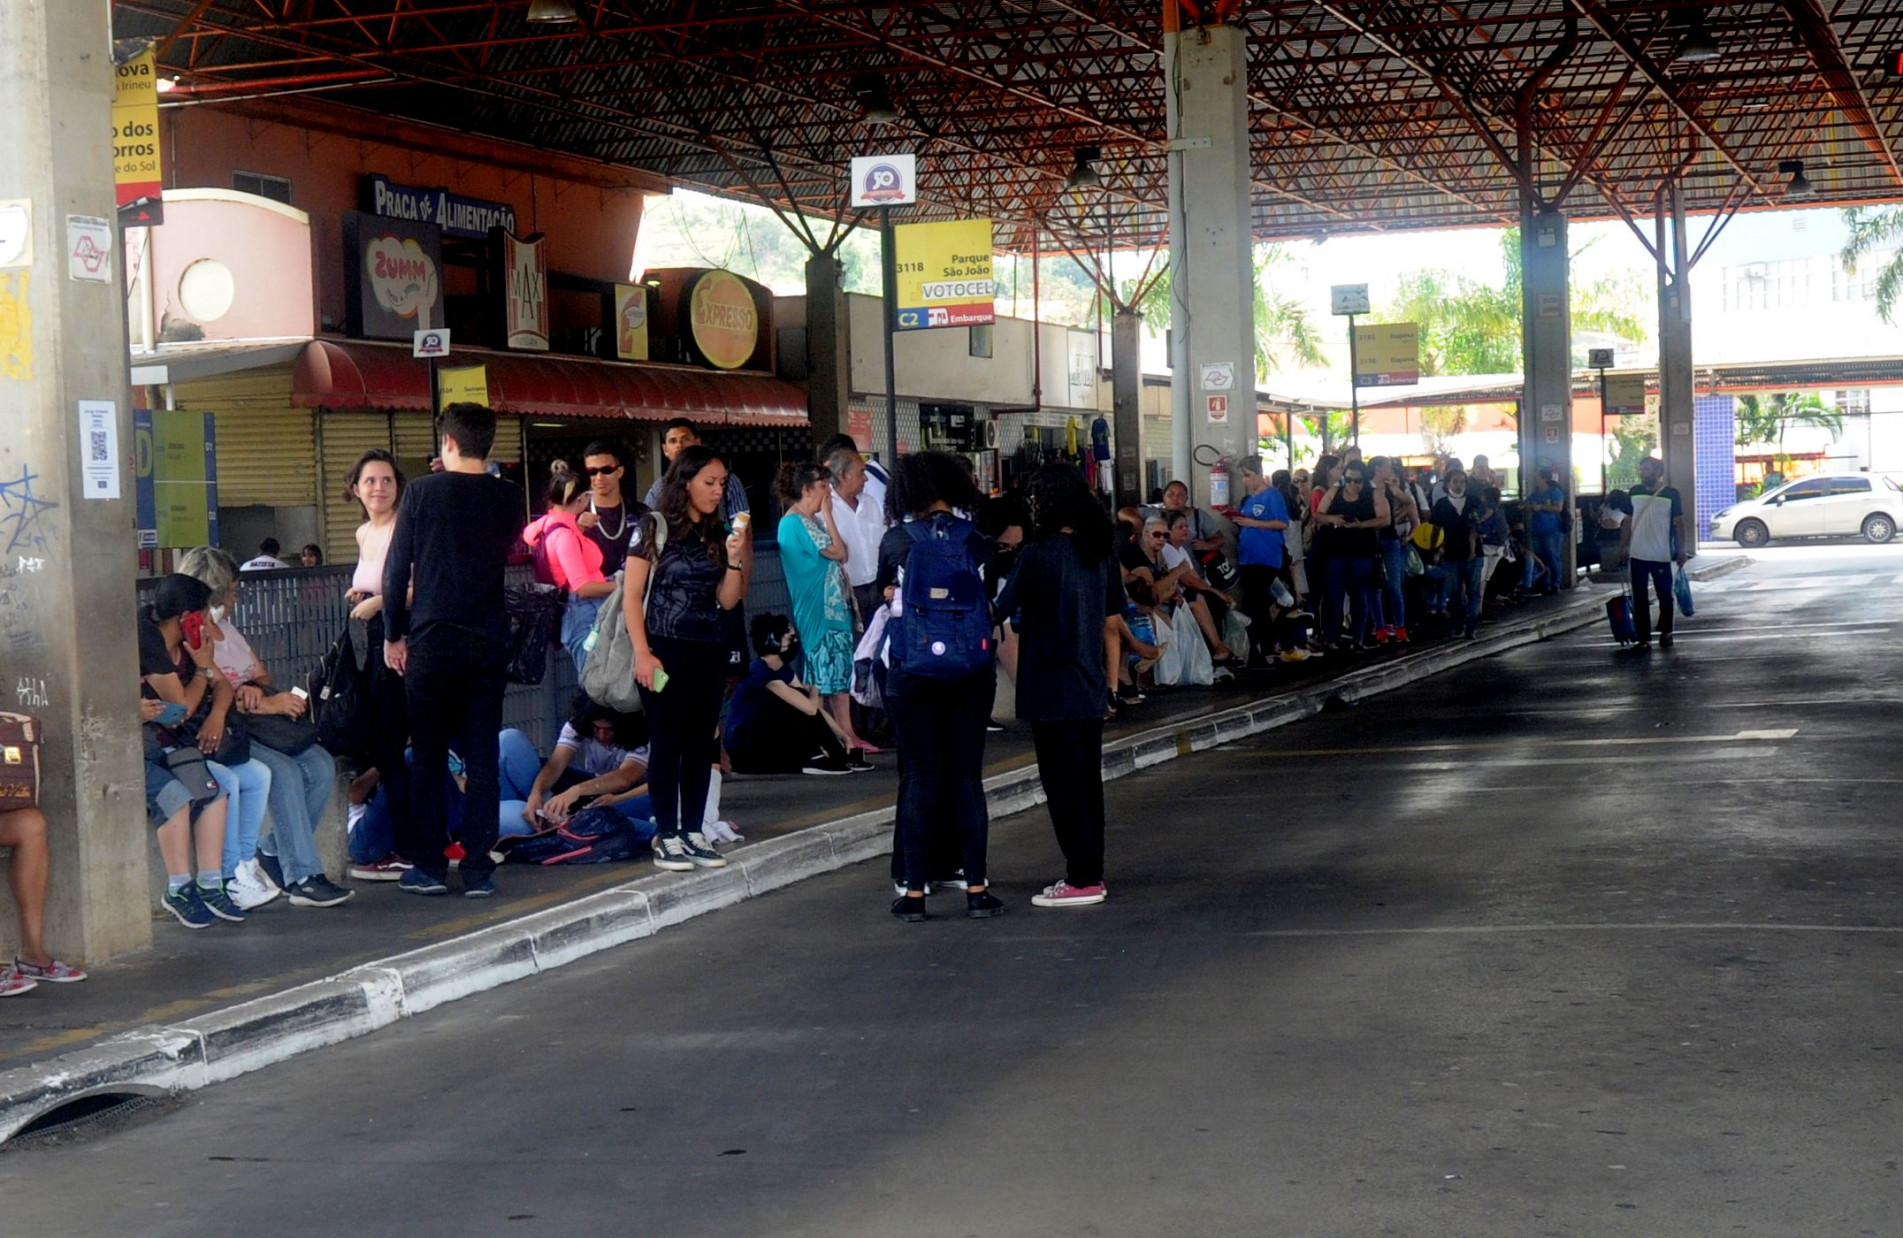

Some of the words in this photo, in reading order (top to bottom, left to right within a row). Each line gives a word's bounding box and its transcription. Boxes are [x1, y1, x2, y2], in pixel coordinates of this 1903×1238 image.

[121, 80, 152, 91] Irineu
[123, 121, 153, 137] dos
[123, 163, 137, 173] do
[140, 161, 155, 172] Sol
[951, 254, 990, 264] Parque
[896, 262, 925, 273] 3118
[943, 267, 963, 277] São
[965, 265, 990, 275] João
[899, 313, 919, 326] C2
[950, 314, 993, 324] Embarque
[135, 429, 154, 477] D
